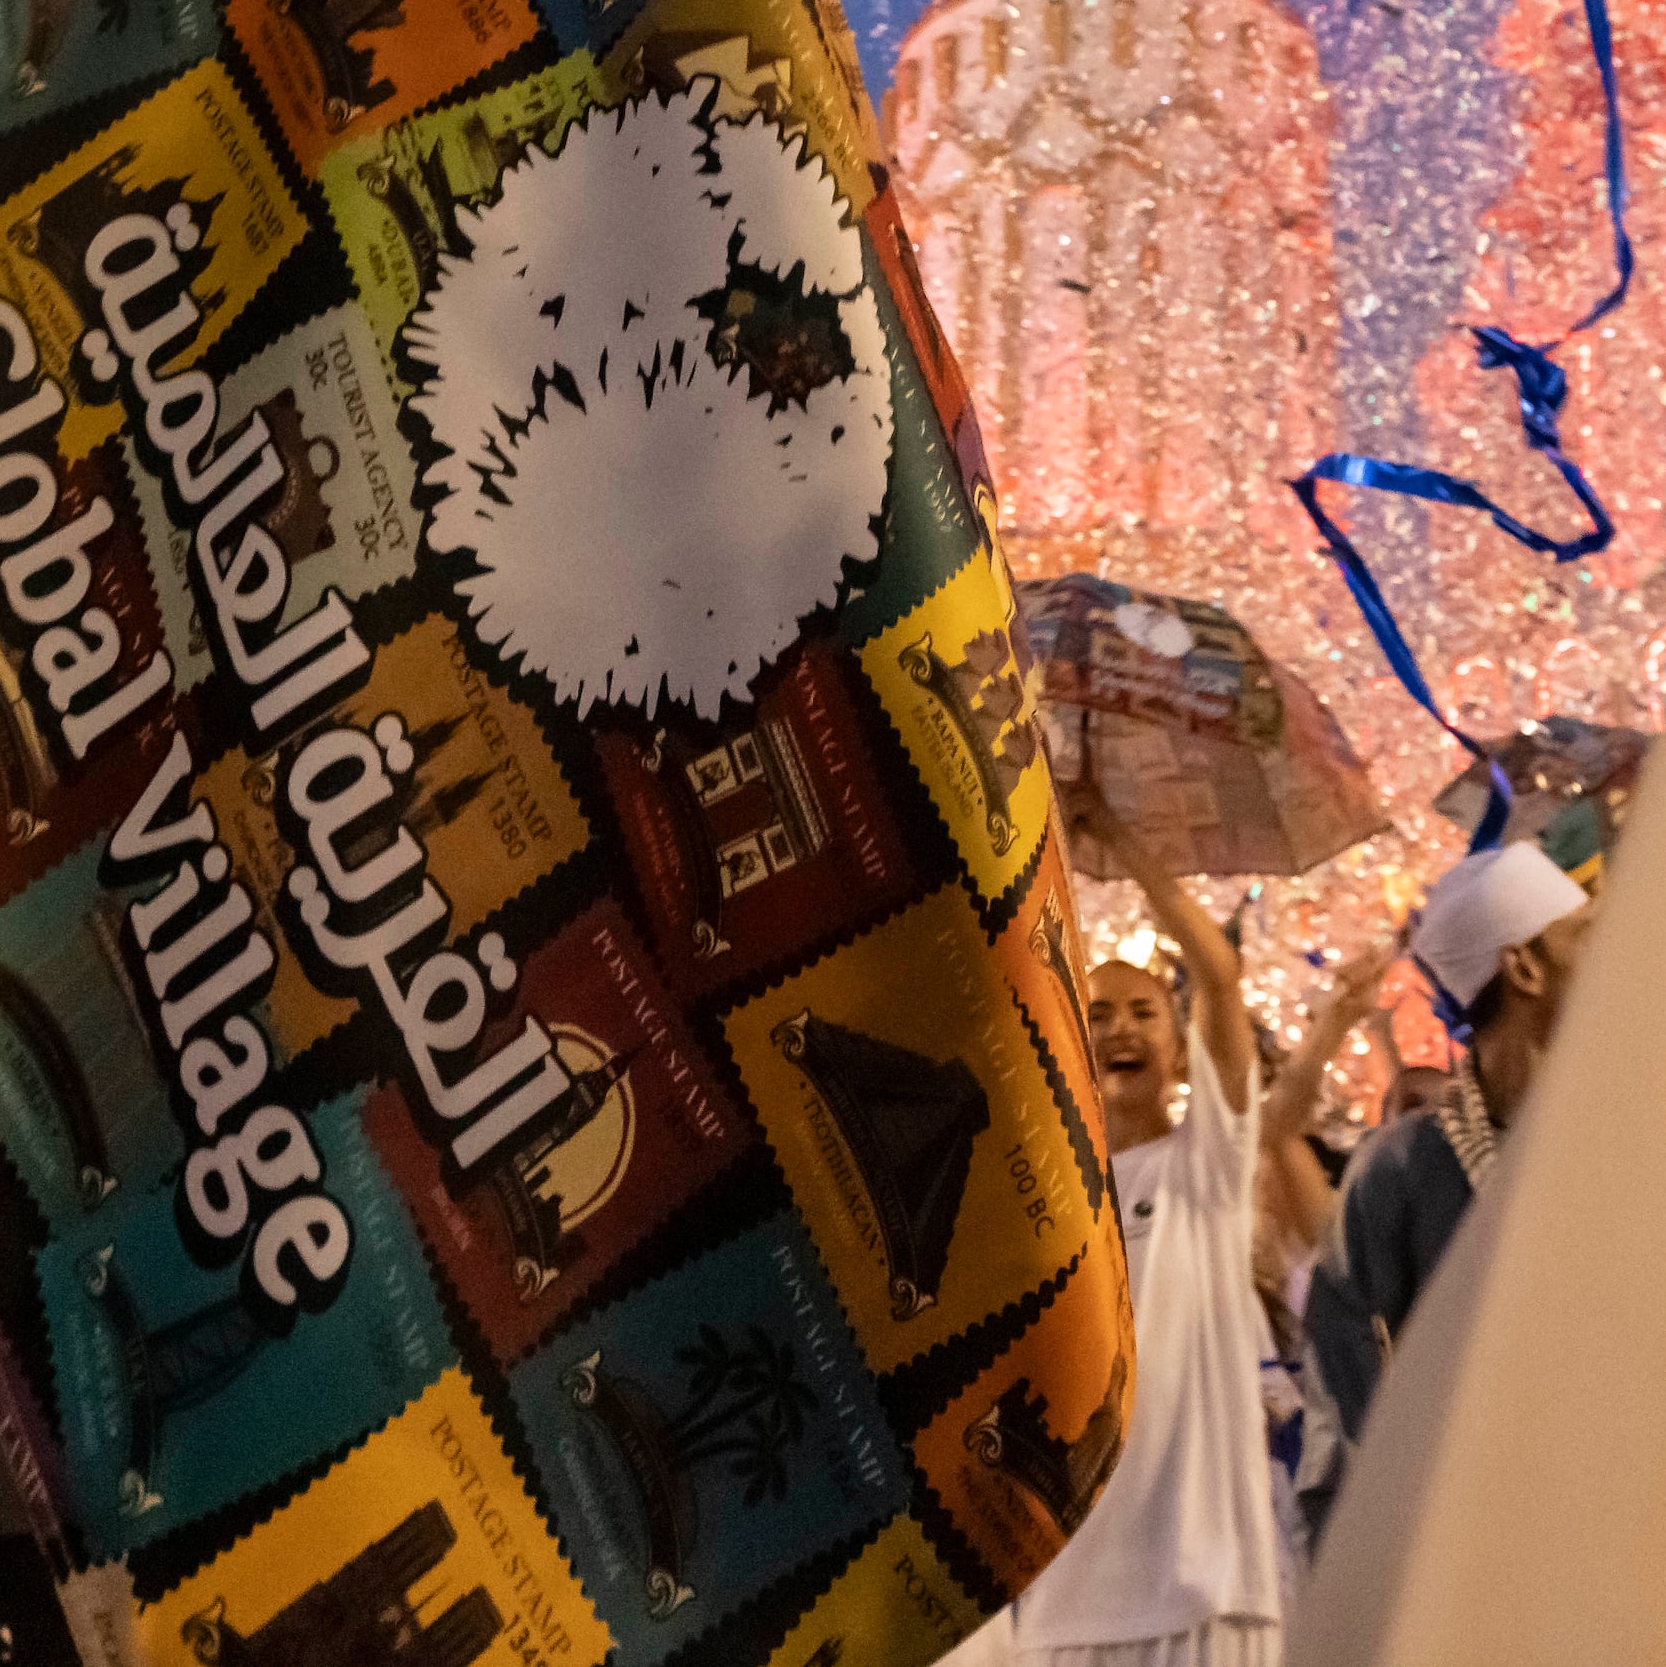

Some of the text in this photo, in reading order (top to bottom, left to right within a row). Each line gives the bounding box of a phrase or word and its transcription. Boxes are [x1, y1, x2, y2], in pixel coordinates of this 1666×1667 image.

[192, 85, 288, 242] POSTAGE STAMP
[301, 346, 333, 391] 30c
[323, 331, 410, 554] TOURIST AGENCY
[352, 513, 385, 562] 30c
[85, 203, 571, 1170] القرية العالمية
[439, 632, 556, 847] POSTAGE STAMP
[928, 708, 983, 796] RAPA NUI
[483, 796, 530, 862] 1380
[834, 782, 888, 882] STAMP
[109, 732, 349, 1305] Village
[589, 927, 670, 1045] POSTAGE
[660, 1048, 727, 1144] STAMP
[1001, 1142, 1058, 1243] 100 BC
[381, 1263, 433, 1374] STAMP
[769, 1244, 837, 1374] POSTAGE
[826, 1382, 886, 1493] STAMP
[425, 1414, 575, 1661] POSTAGE STAMP
